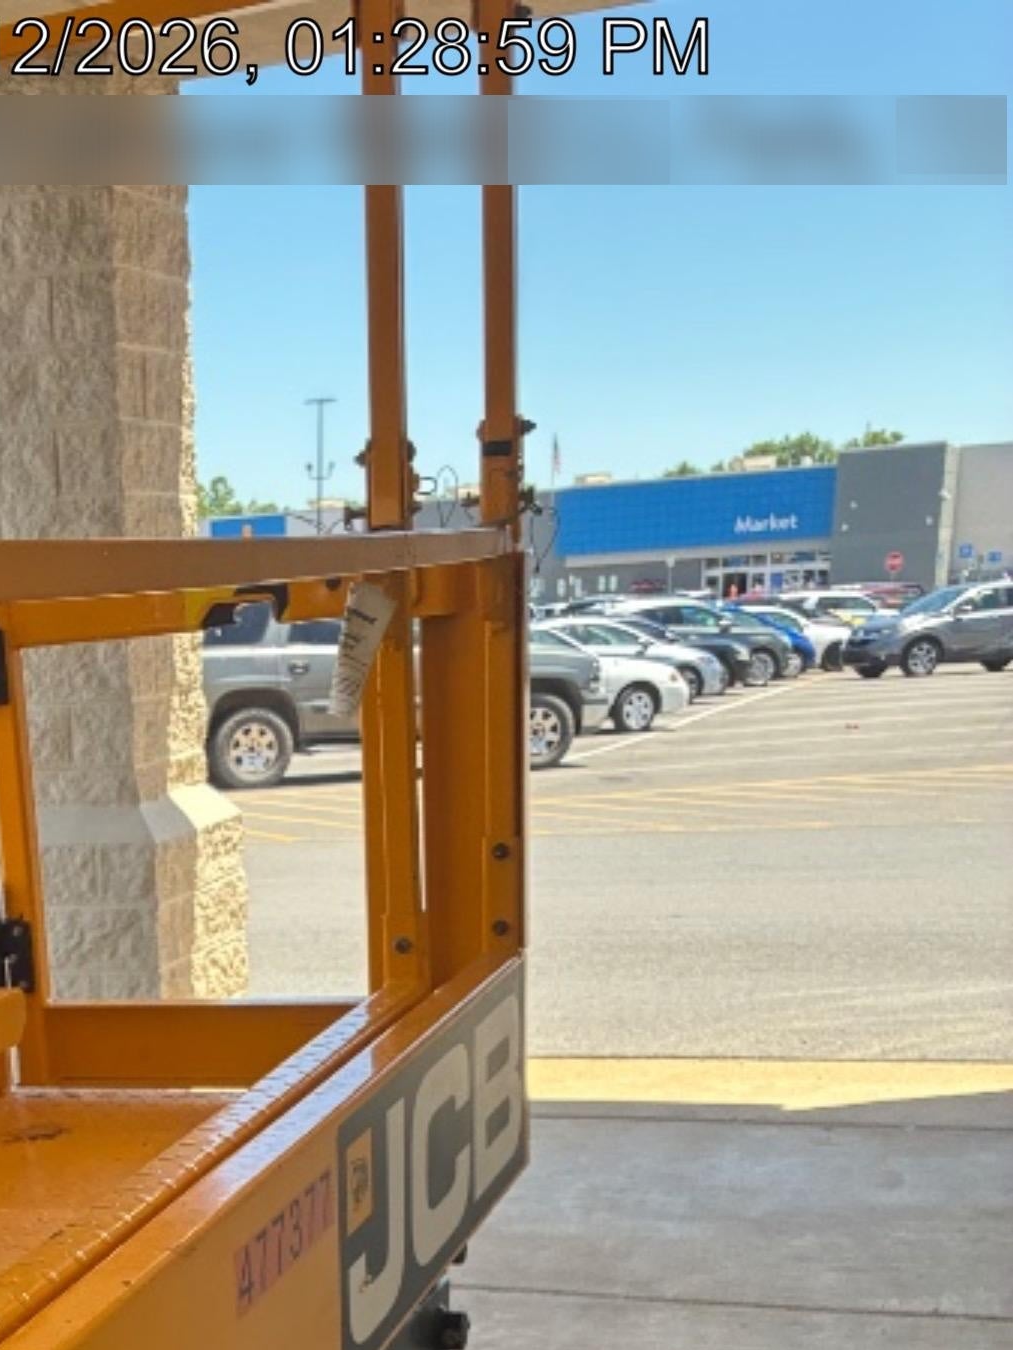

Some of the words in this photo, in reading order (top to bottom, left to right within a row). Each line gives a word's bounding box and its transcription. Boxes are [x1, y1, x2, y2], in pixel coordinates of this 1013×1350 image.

[734, 512, 799, 535] Market
[238, 1168, 332, 1305] 477377
[347, 995, 523, 1345] JCB
